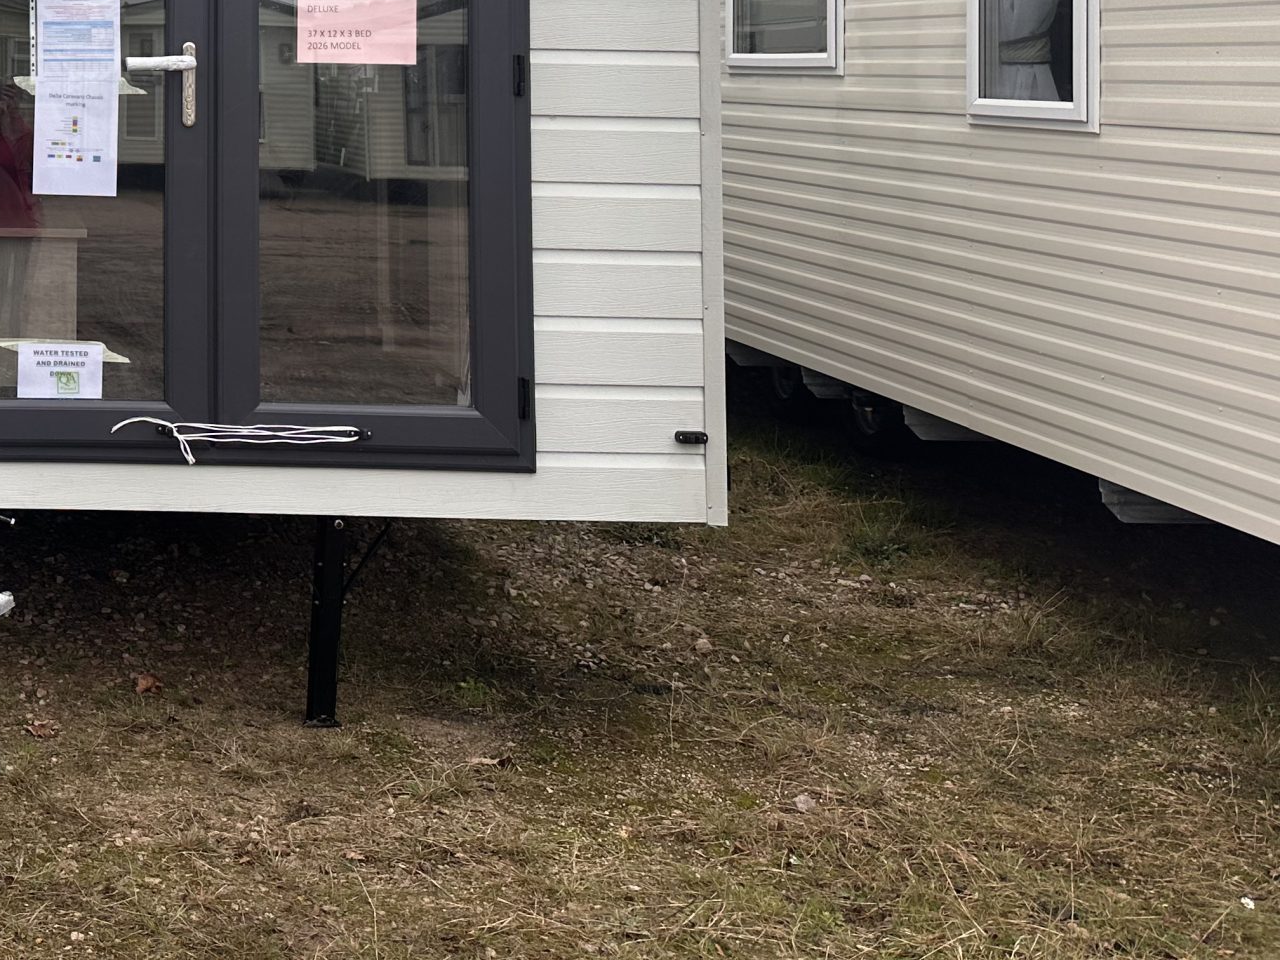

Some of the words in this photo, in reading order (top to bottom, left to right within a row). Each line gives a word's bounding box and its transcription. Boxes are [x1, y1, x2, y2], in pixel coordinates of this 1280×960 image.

[307, 5, 339, 13] DELUXE
[307, 42, 328, 50] 2026
[330, 42, 361, 50] MODEL
